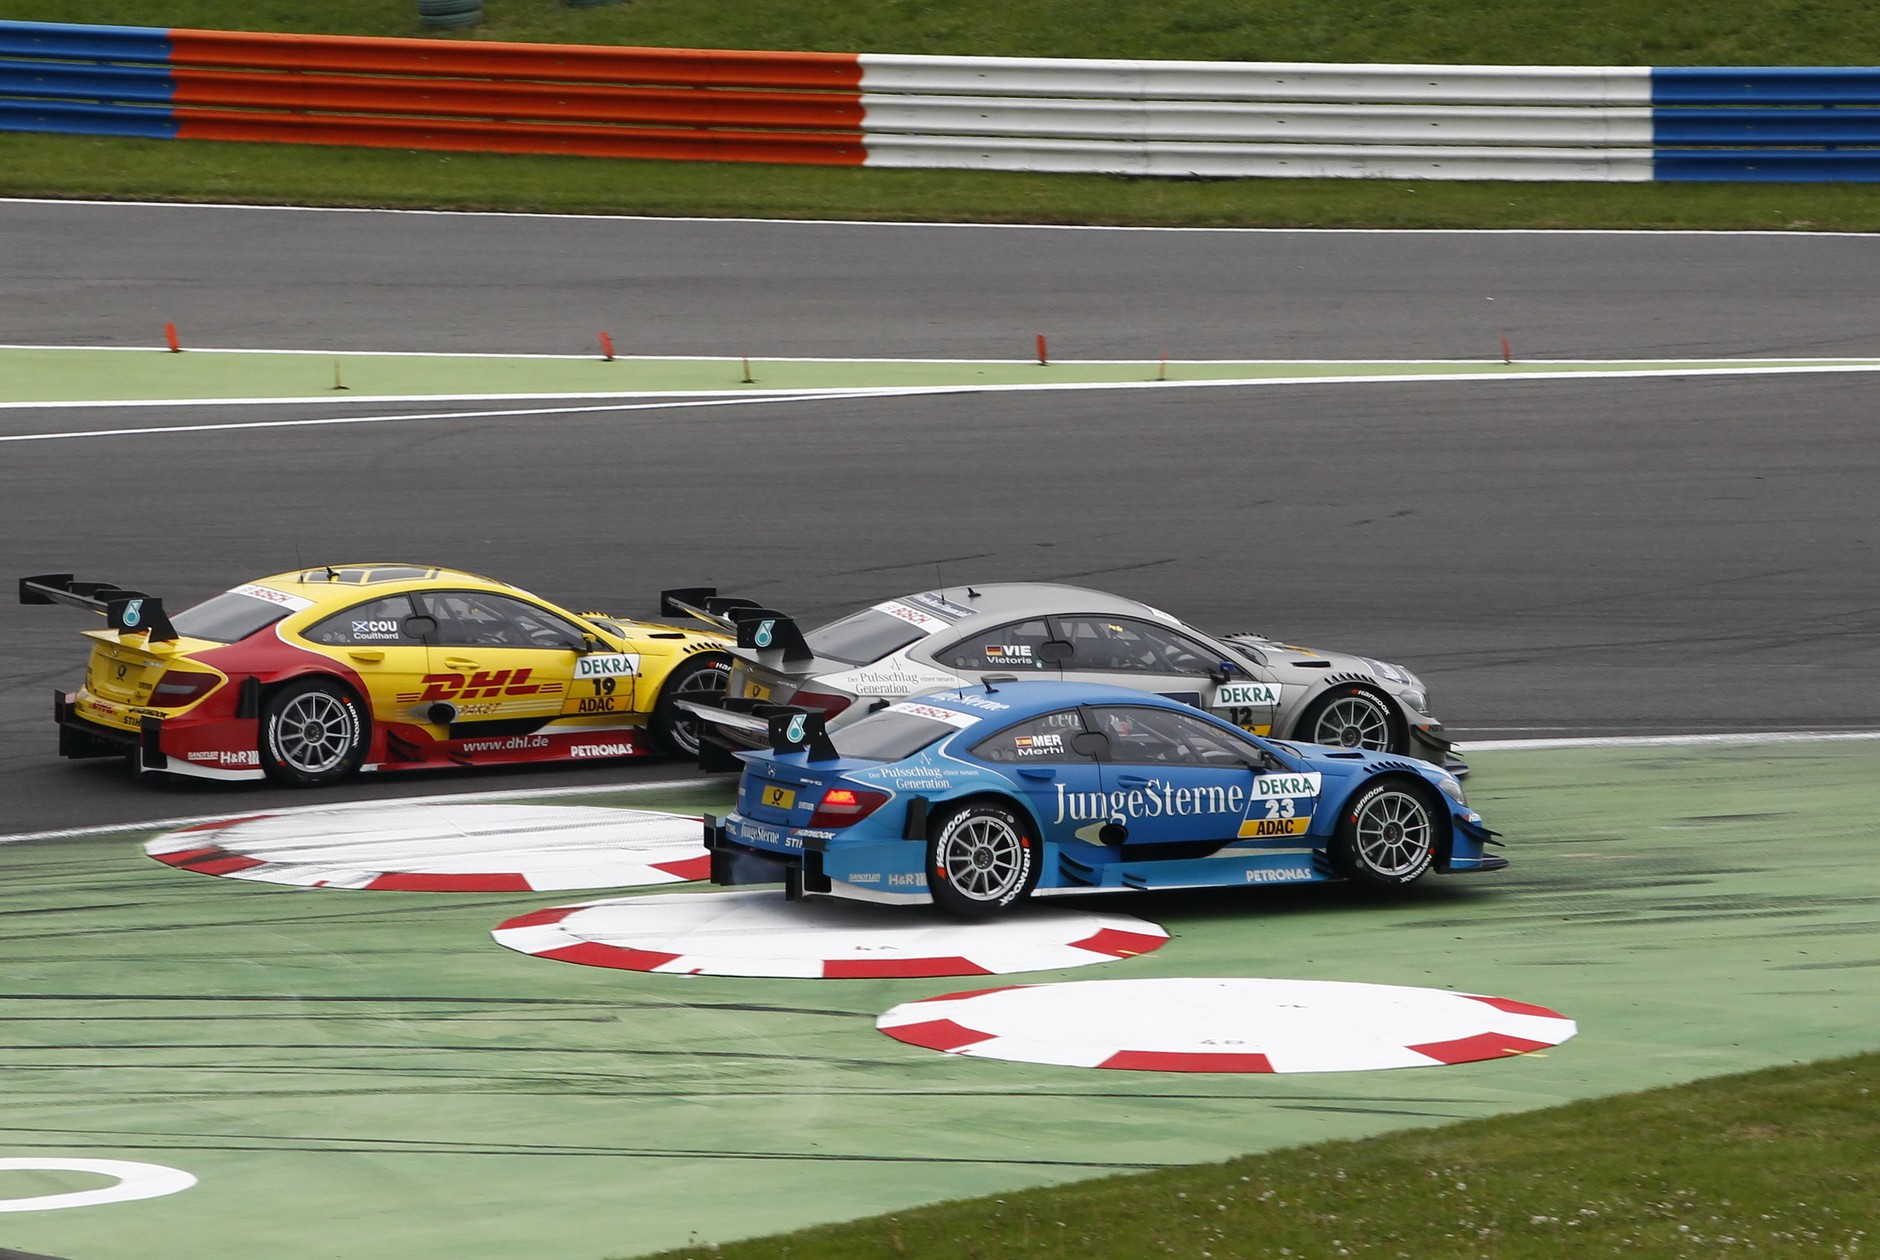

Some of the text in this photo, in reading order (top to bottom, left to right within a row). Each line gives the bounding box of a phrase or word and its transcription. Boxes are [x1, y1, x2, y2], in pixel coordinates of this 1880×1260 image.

[369, 620, 398, 632] COU
[353, 632, 399, 640] Coulthard
[1002, 645, 1032, 657] VIE
[580, 656, 633, 675] DEKRA
[987, 656, 1033, 665] Vietoris
[420, 668, 542, 701] DHL
[859, 672, 919, 685] Pulsschlag
[592, 677, 616, 697] 19
[855, 683, 911, 695] Generation.
[1220, 687, 1276, 703] DEKRA
[578, 698, 615, 712] ADAC
[123, 716, 141, 727] STIH
[1229, 706, 1253, 726] 12
[463, 735, 549, 752] www.dhl.de
[1032, 734, 1063, 747] MER
[570, 743, 634, 757] PETRONAS
[1018, 746, 1065, 757] Merhi
[220, 751, 248, 764] H&R
[880, 766, 942, 779] Pulsschlag
[896, 777, 953, 790] Generation.
[1258, 777, 1316, 795] DEKRA
[1053, 778, 1244, 827] JungeSterne
[1265, 799, 1296, 819] 23
[1256, 819, 1294, 835] ADAC
[889, 874, 914, 886] H&R
[1245, 868, 1313, 882] PETRONAS
